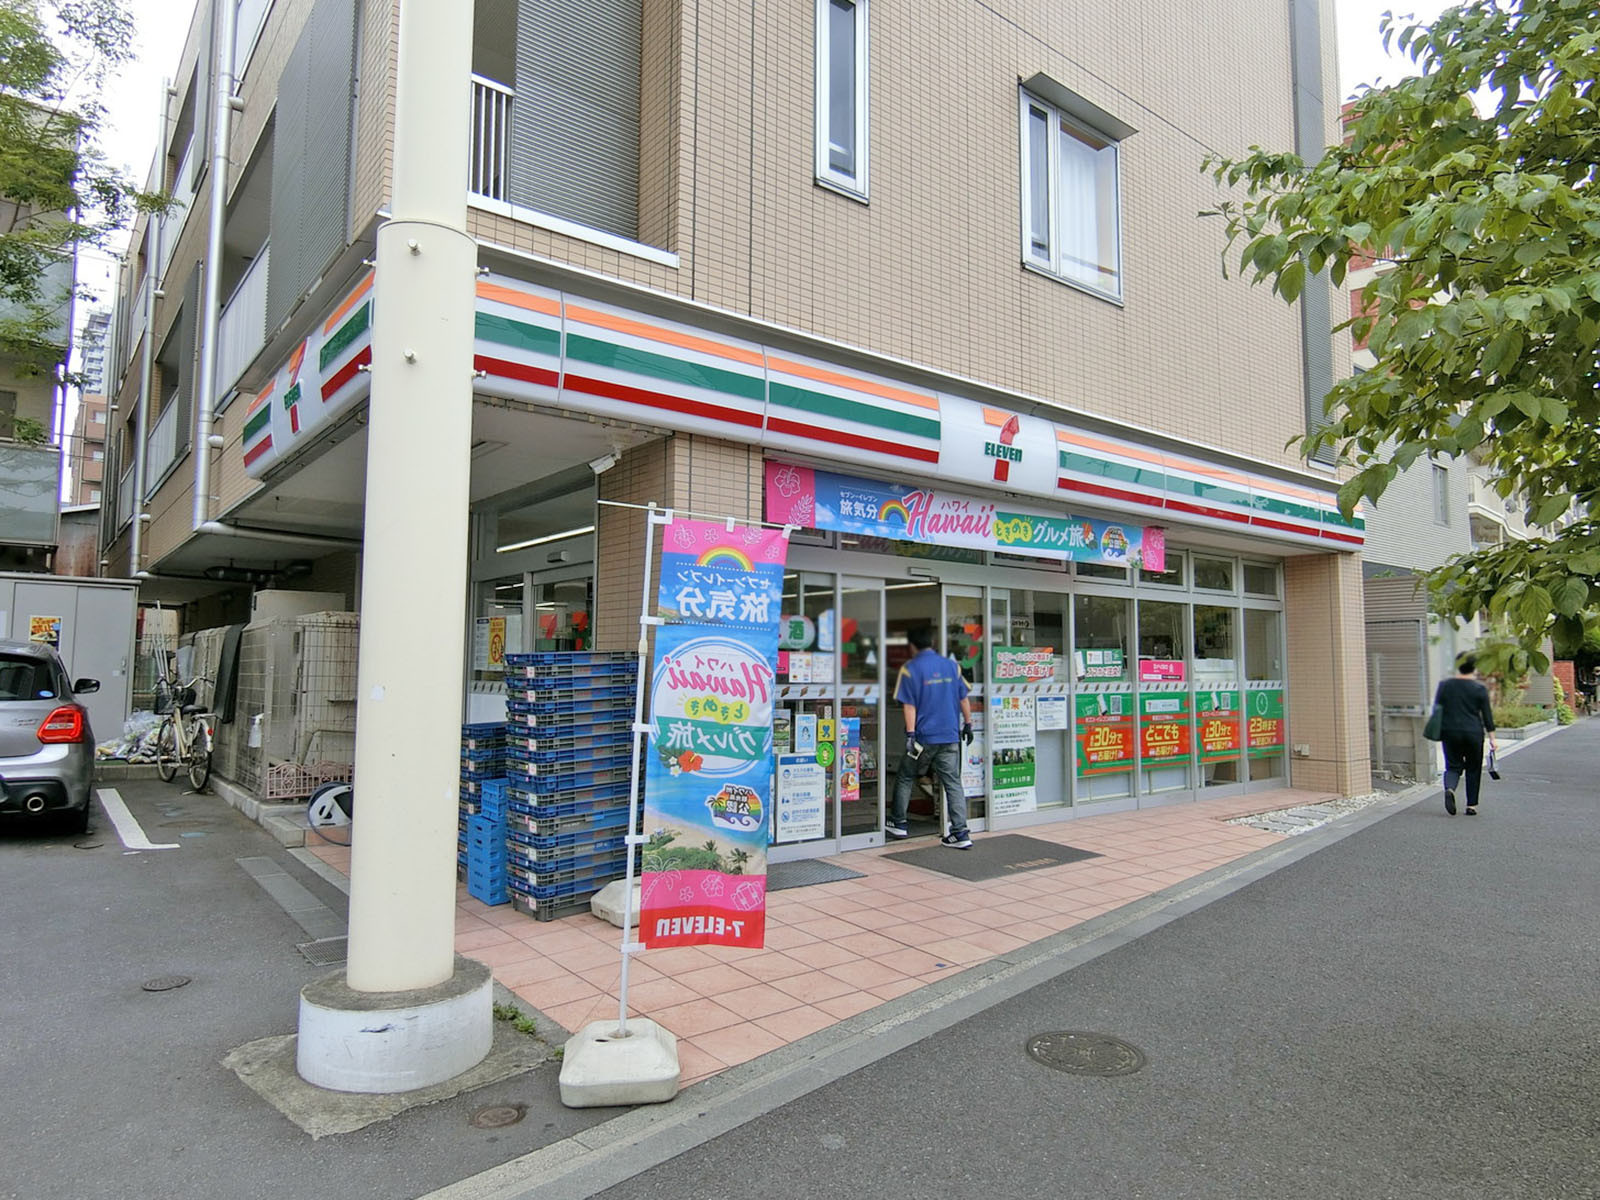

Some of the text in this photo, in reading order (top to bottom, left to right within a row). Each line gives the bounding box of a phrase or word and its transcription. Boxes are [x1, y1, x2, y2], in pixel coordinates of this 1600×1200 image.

[839, 500, 878, 520] 旅気分
[902, 491, 994, 538] Hawaii
[940, 500, 970, 513] ハワイ
[1033, 520, 1085, 548] グルメ旅
[788, 620, 805, 640] 酒
[1145, 723, 1180, 742] どこでも
